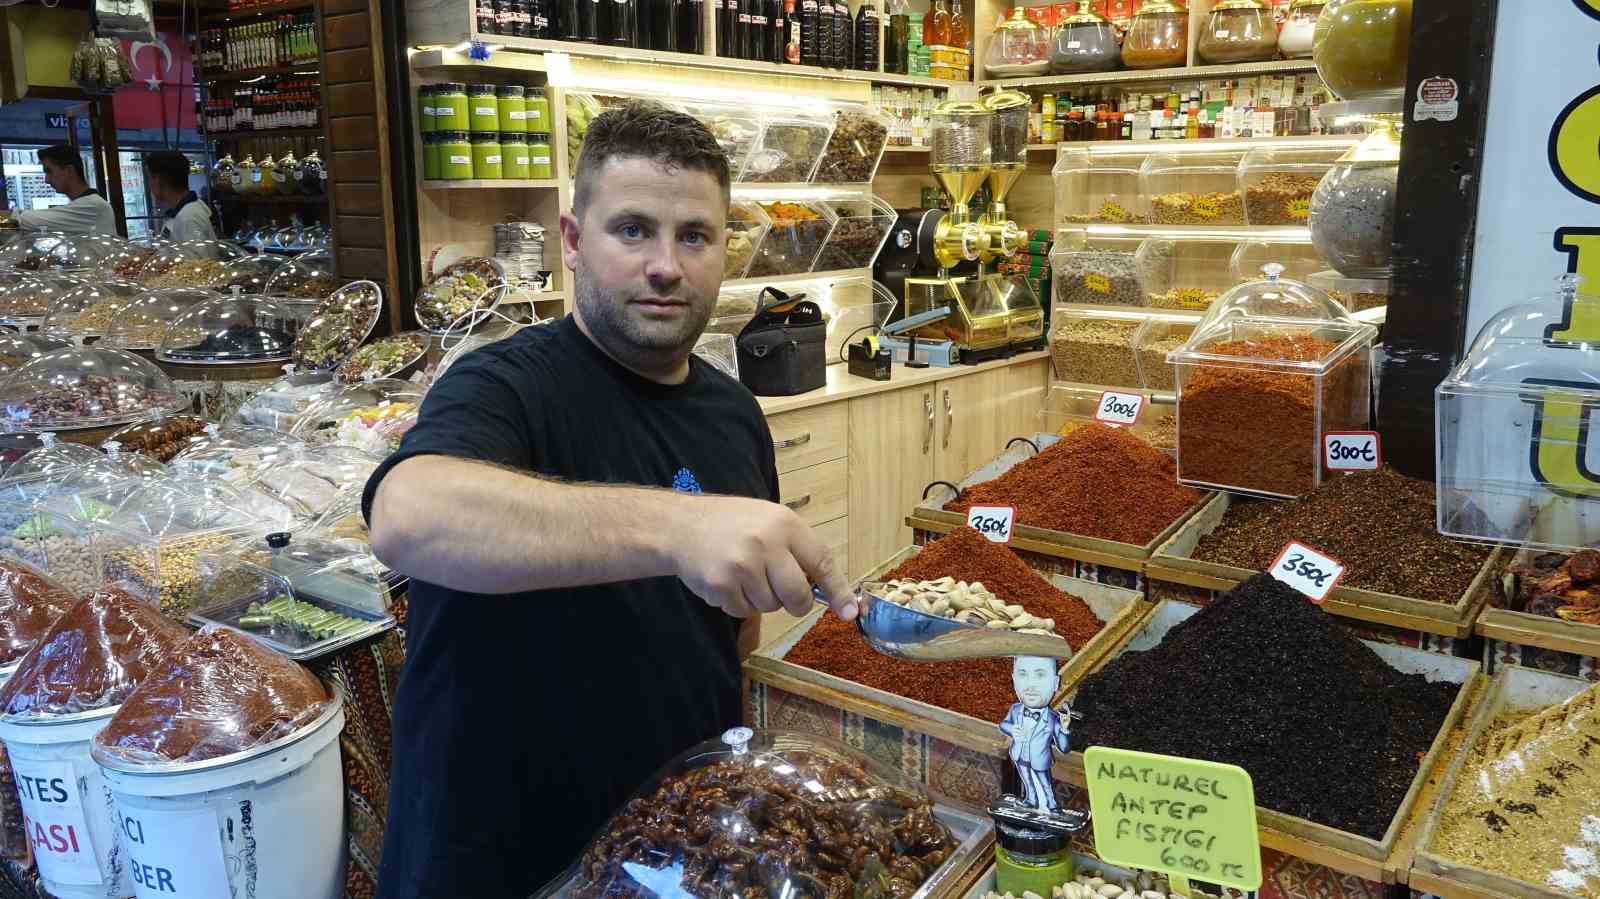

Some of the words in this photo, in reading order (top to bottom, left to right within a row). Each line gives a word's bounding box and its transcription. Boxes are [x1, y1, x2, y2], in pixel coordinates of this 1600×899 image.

[1097, 761, 1228, 800] NATUREL
[1111, 791, 1208, 820] ANTEP
[1160, 847, 1210, 873] 600
